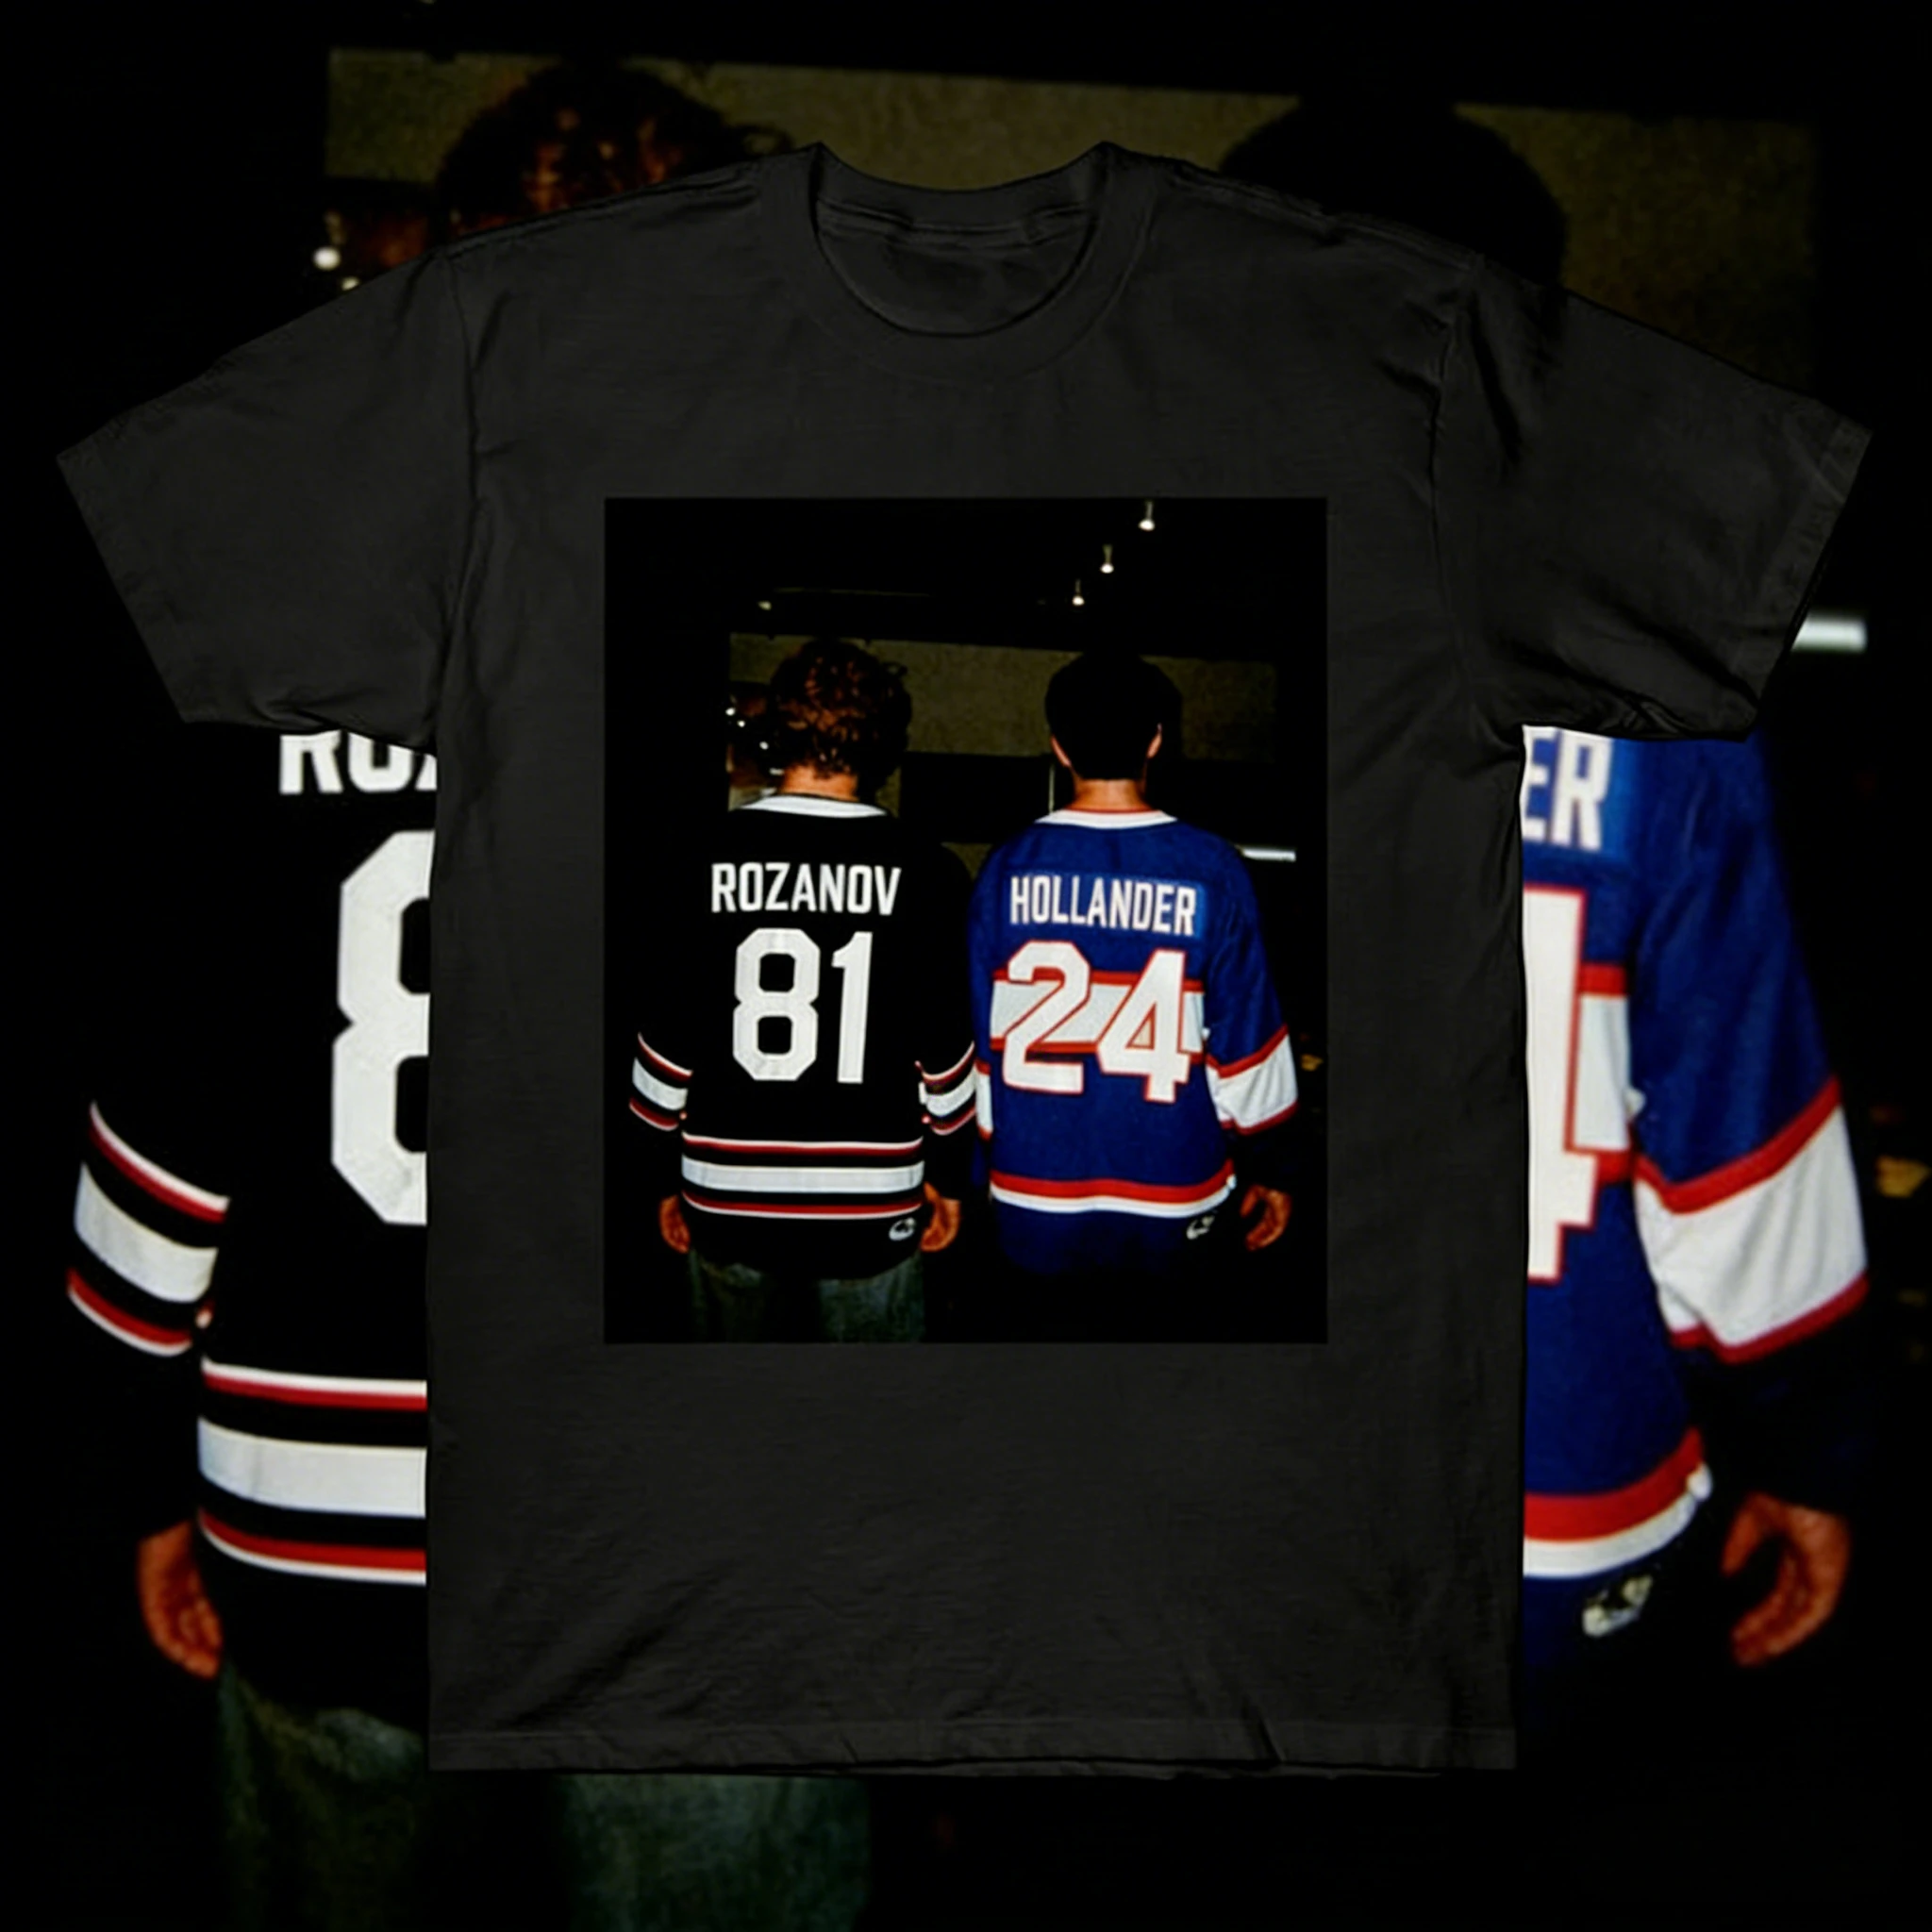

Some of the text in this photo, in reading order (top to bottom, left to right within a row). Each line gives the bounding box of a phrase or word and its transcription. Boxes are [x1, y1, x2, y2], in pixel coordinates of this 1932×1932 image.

[710, 860, 903, 916] ROZANOV
[1008, 874, 1198, 938] HOLLANDER
[731, 926, 874, 1085] 81
[1001, 939, 1191, 1104] 24
